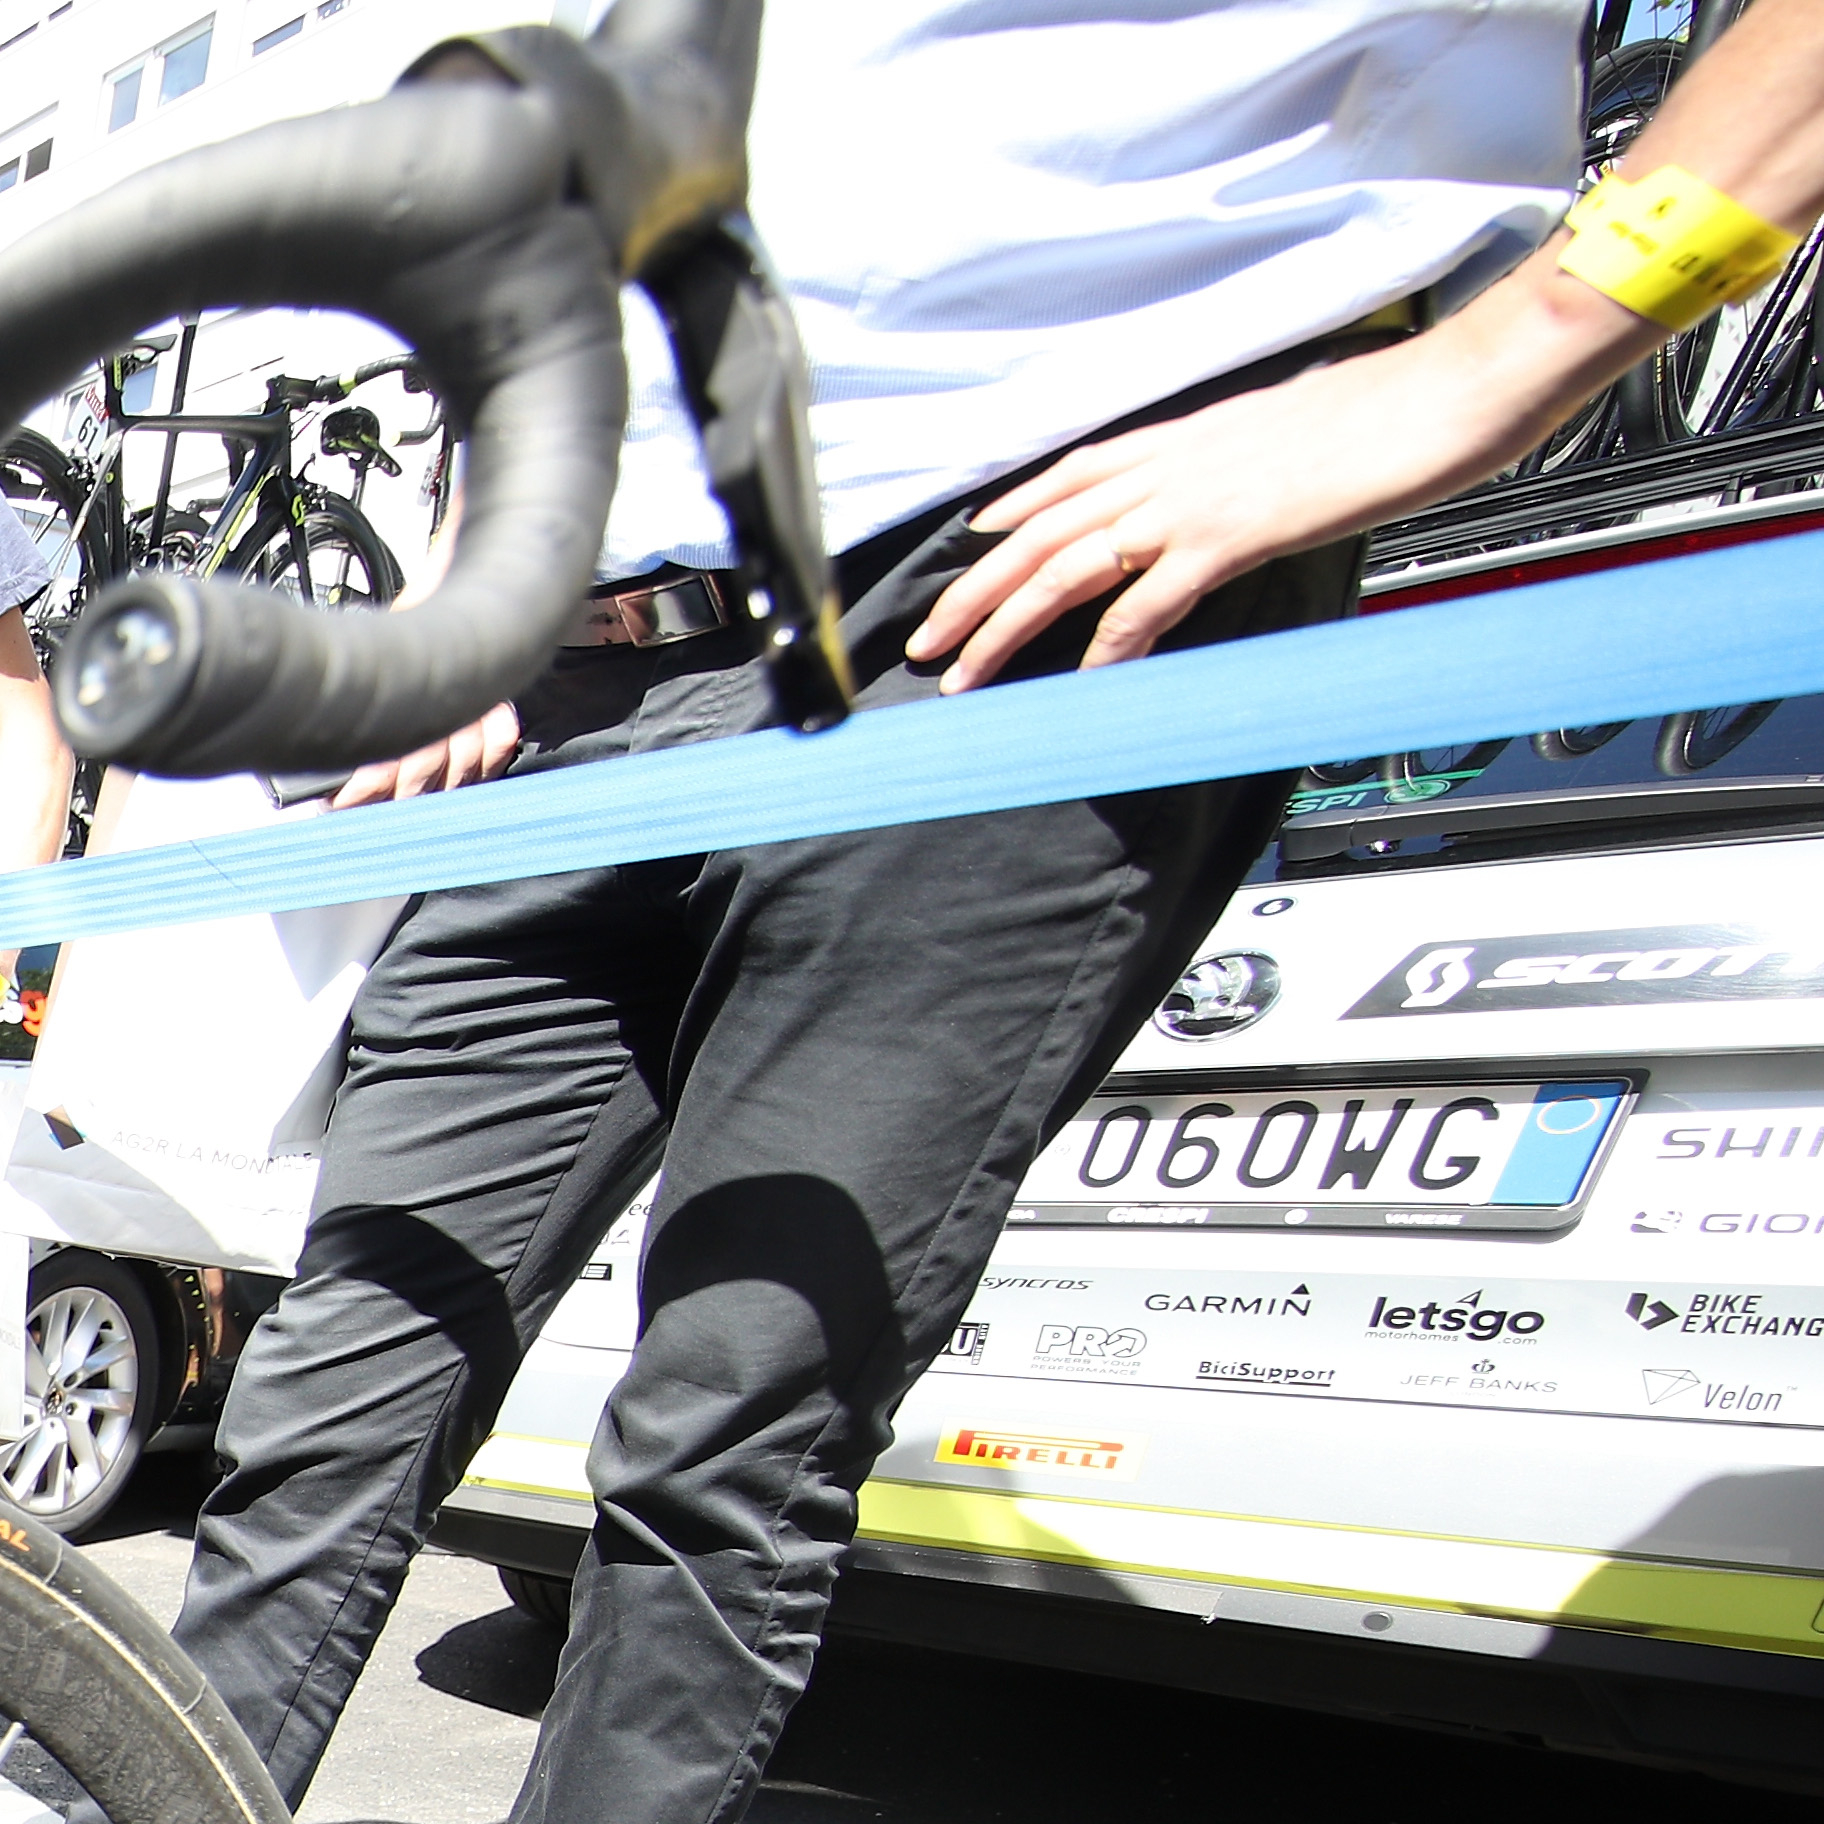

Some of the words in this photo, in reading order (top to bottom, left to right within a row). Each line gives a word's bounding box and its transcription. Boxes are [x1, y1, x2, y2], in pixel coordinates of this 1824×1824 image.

[78, 415, 98, 451] 61
[112, 1131, 169, 1155] AG2R
[177, 1142, 203, 1162] LA
[1656, 1126, 1824, 1159] SHI
[1699, 1213, 1824, 1234] GIO
[980, 1276, 1095, 1291] syncros
[1145, 1293, 1312, 1317] GARMIN
[1689, 1294, 1763, 1314] BIKE
[1367, 1297, 1545, 1342] letsgo
[1035, 1324, 1147, 1358] PRO
[1364, 1330, 1459, 1343] motorhomes
[1029, 1363, 1139, 1377] PERFORMANCE
[1033, 1353, 1092, 1366] POWERS
[1101, 1358, 1142, 1368] YOUR
[1198, 1360, 1337, 1384] BiciSupport
[1400, 1373, 1460, 1389] JEFF
[1468, 1377, 1559, 1394] BANKS
[1703, 1382, 1783, 1412] Velon
[952, 1429, 1125, 1470] PIRELLI
